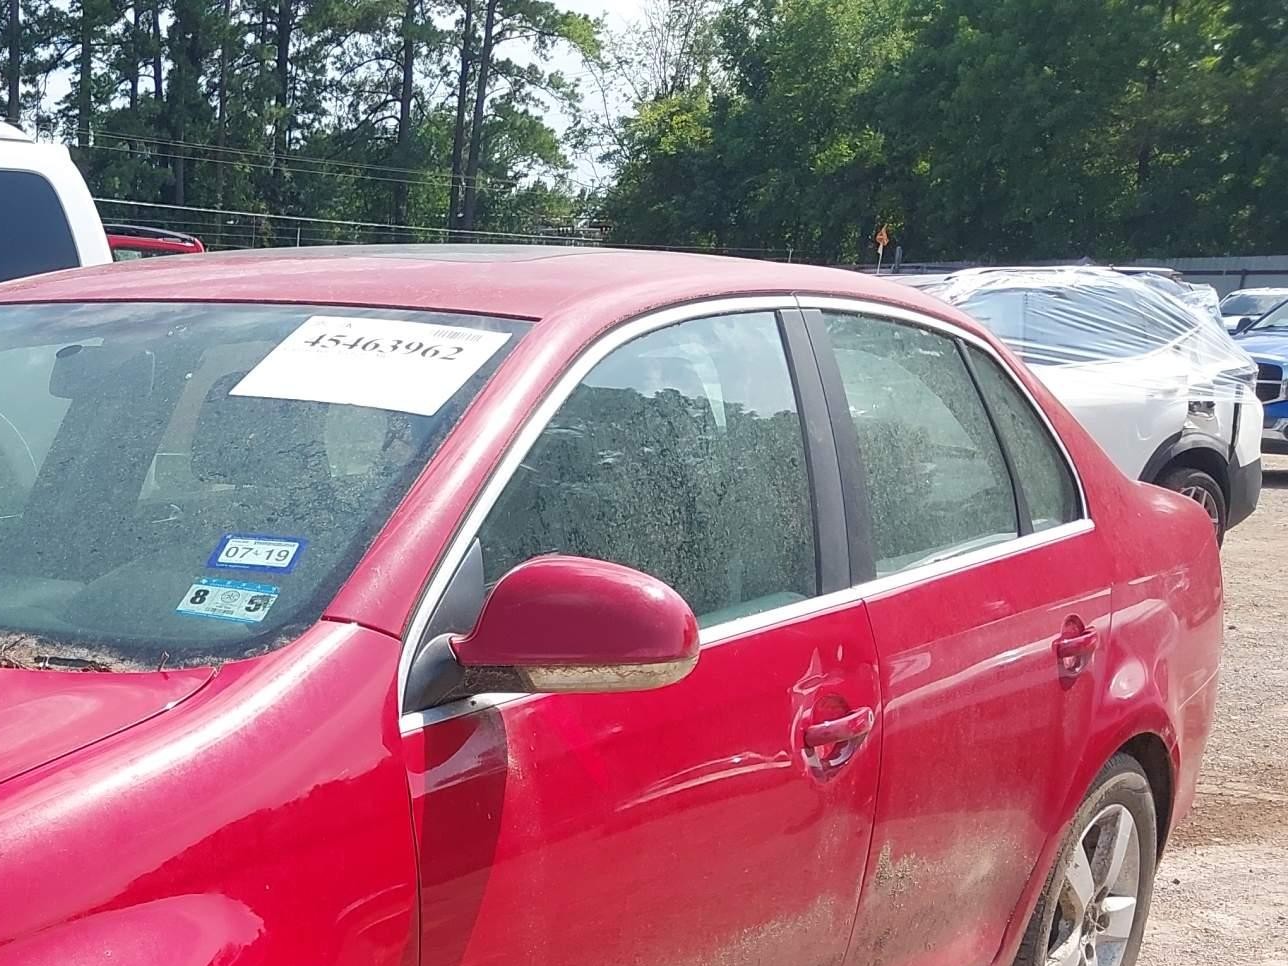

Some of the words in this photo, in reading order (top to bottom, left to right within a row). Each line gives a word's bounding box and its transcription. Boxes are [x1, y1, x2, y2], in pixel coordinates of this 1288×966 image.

[304, 333, 464, 361] 45463962
[225, 546, 253, 560] 07
[264, 548, 290, 562] 19
[189, 589, 210, 605] 8
